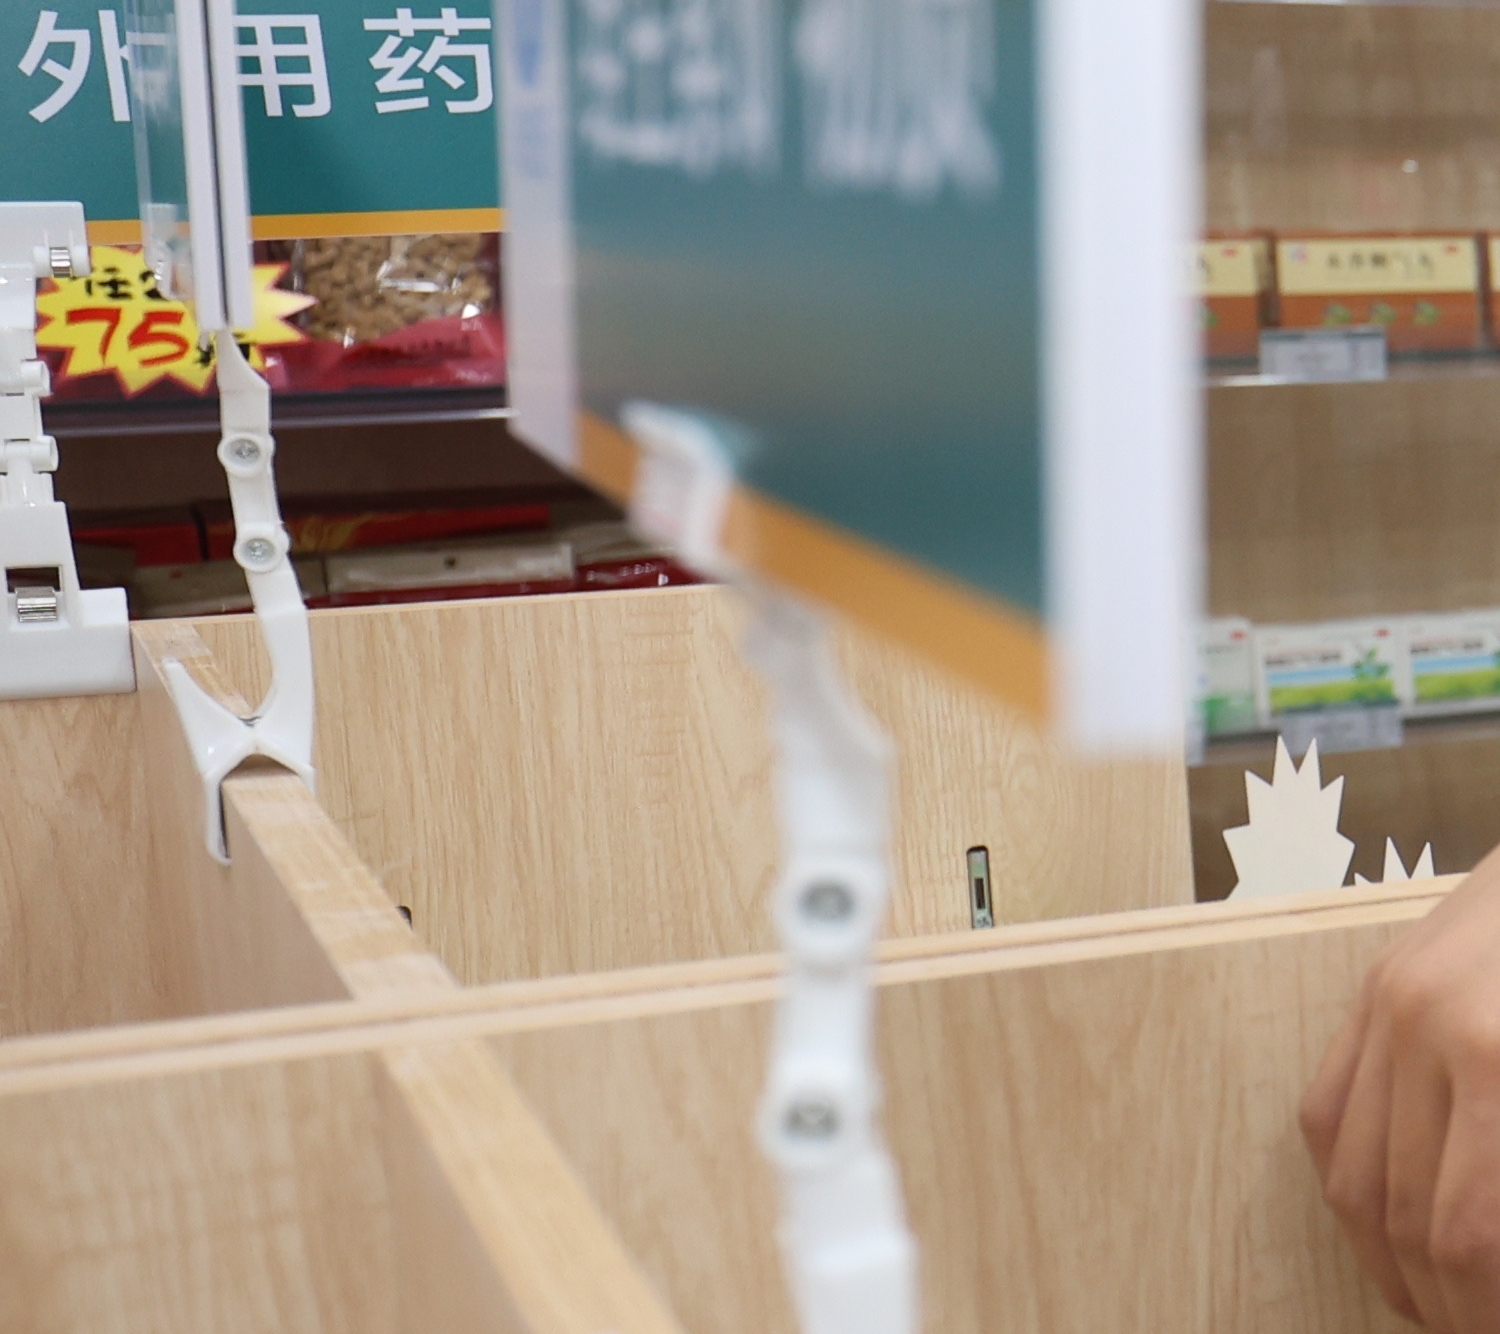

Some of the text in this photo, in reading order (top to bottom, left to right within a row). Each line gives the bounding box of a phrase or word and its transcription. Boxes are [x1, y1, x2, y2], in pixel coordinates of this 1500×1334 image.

[17, 7, 495, 123] 外用药
[65, 307, 191, 368] 75
